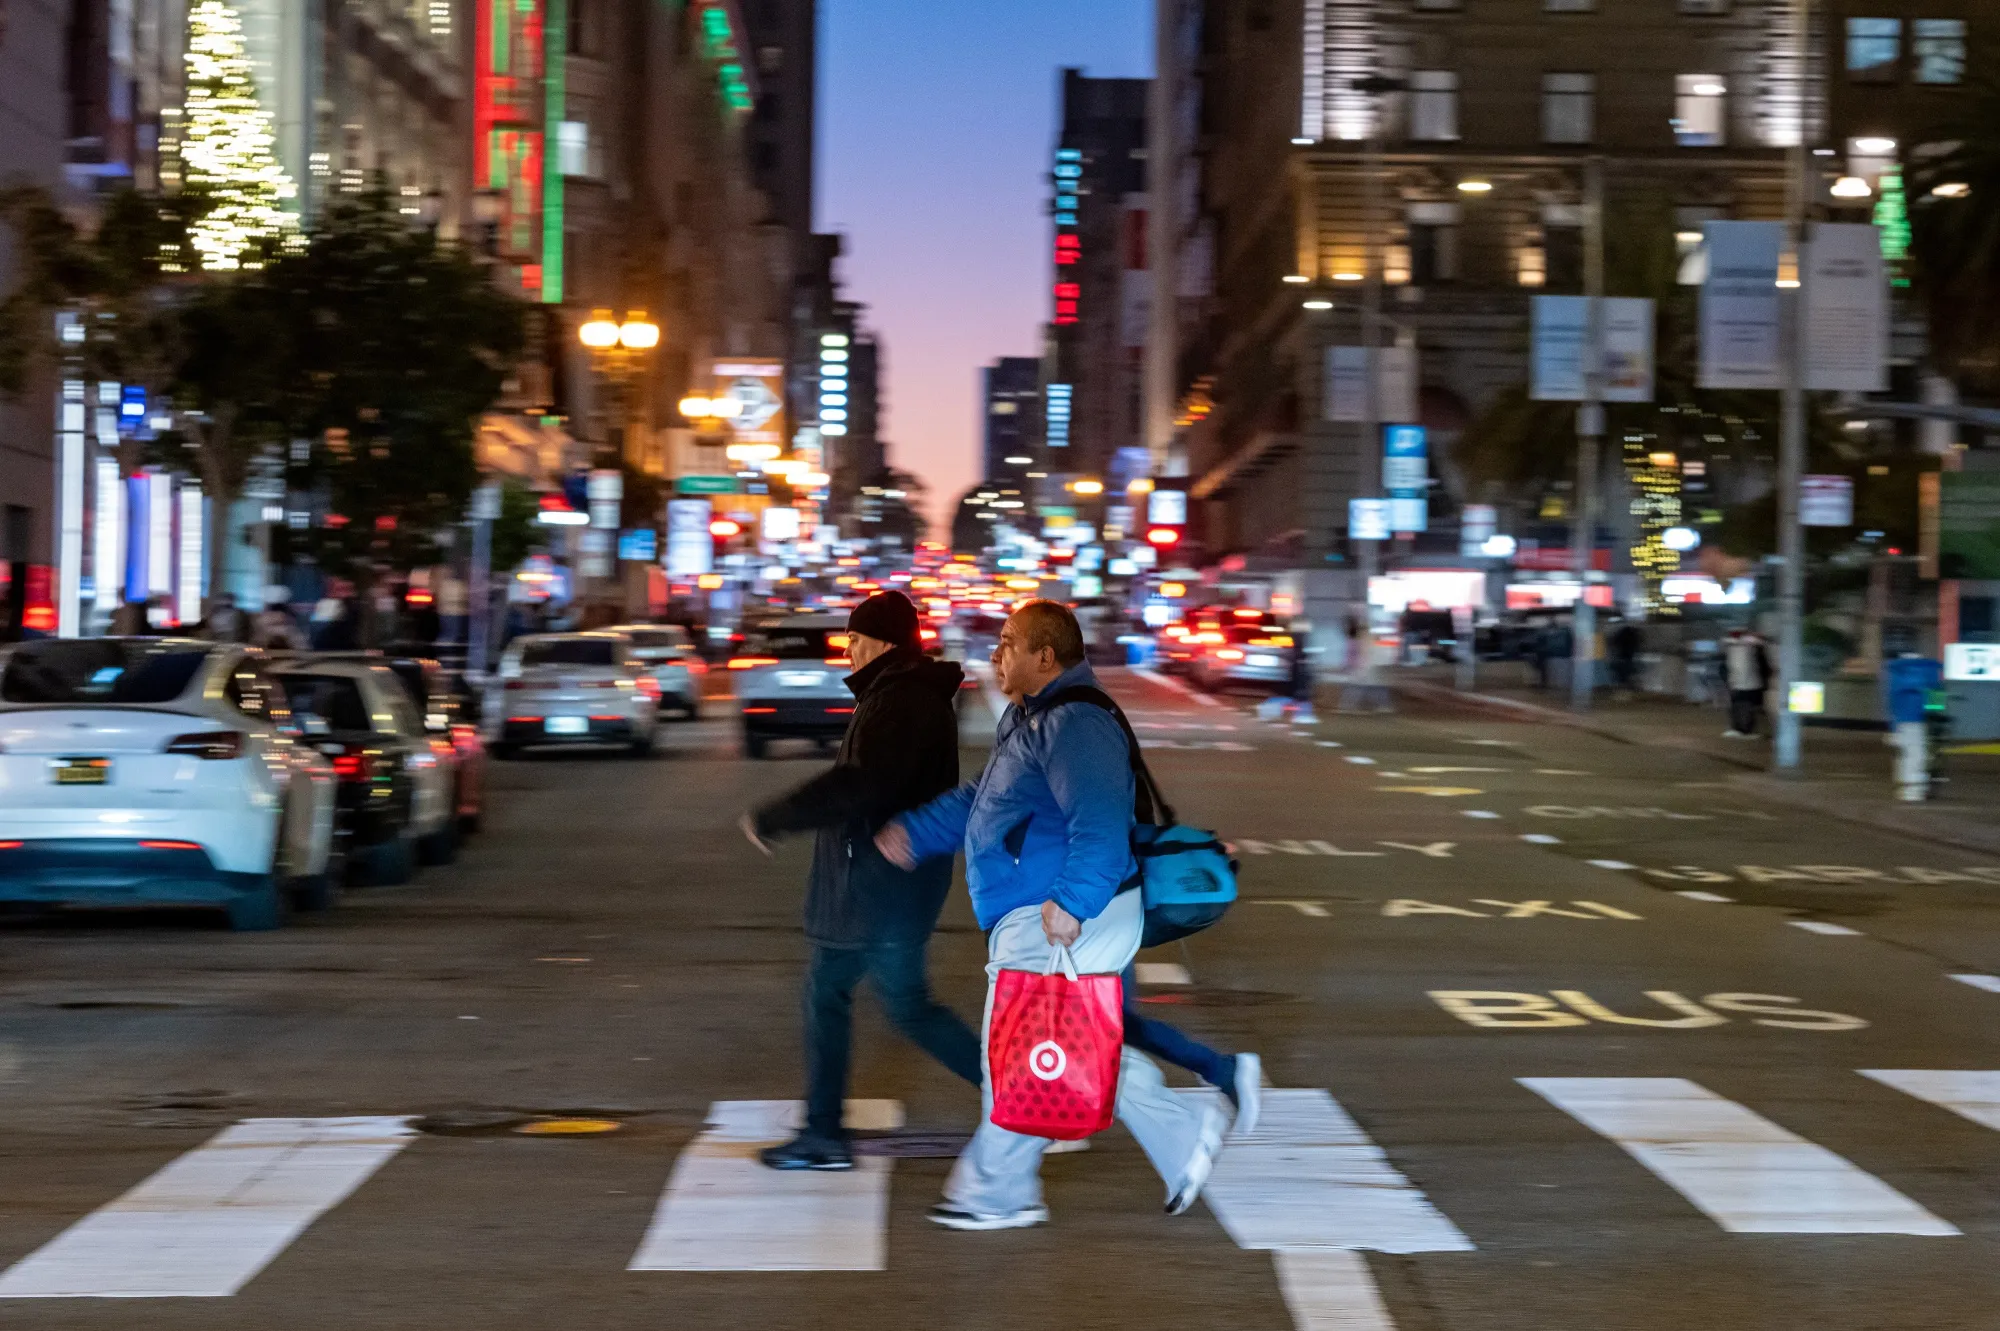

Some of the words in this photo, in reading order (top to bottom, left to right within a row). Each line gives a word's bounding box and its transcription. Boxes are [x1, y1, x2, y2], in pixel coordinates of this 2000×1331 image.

[1237, 839, 1458, 857] NLY
[1247, 899, 1645, 920] TAXI
[1425, 990, 1872, 1030] BUS
